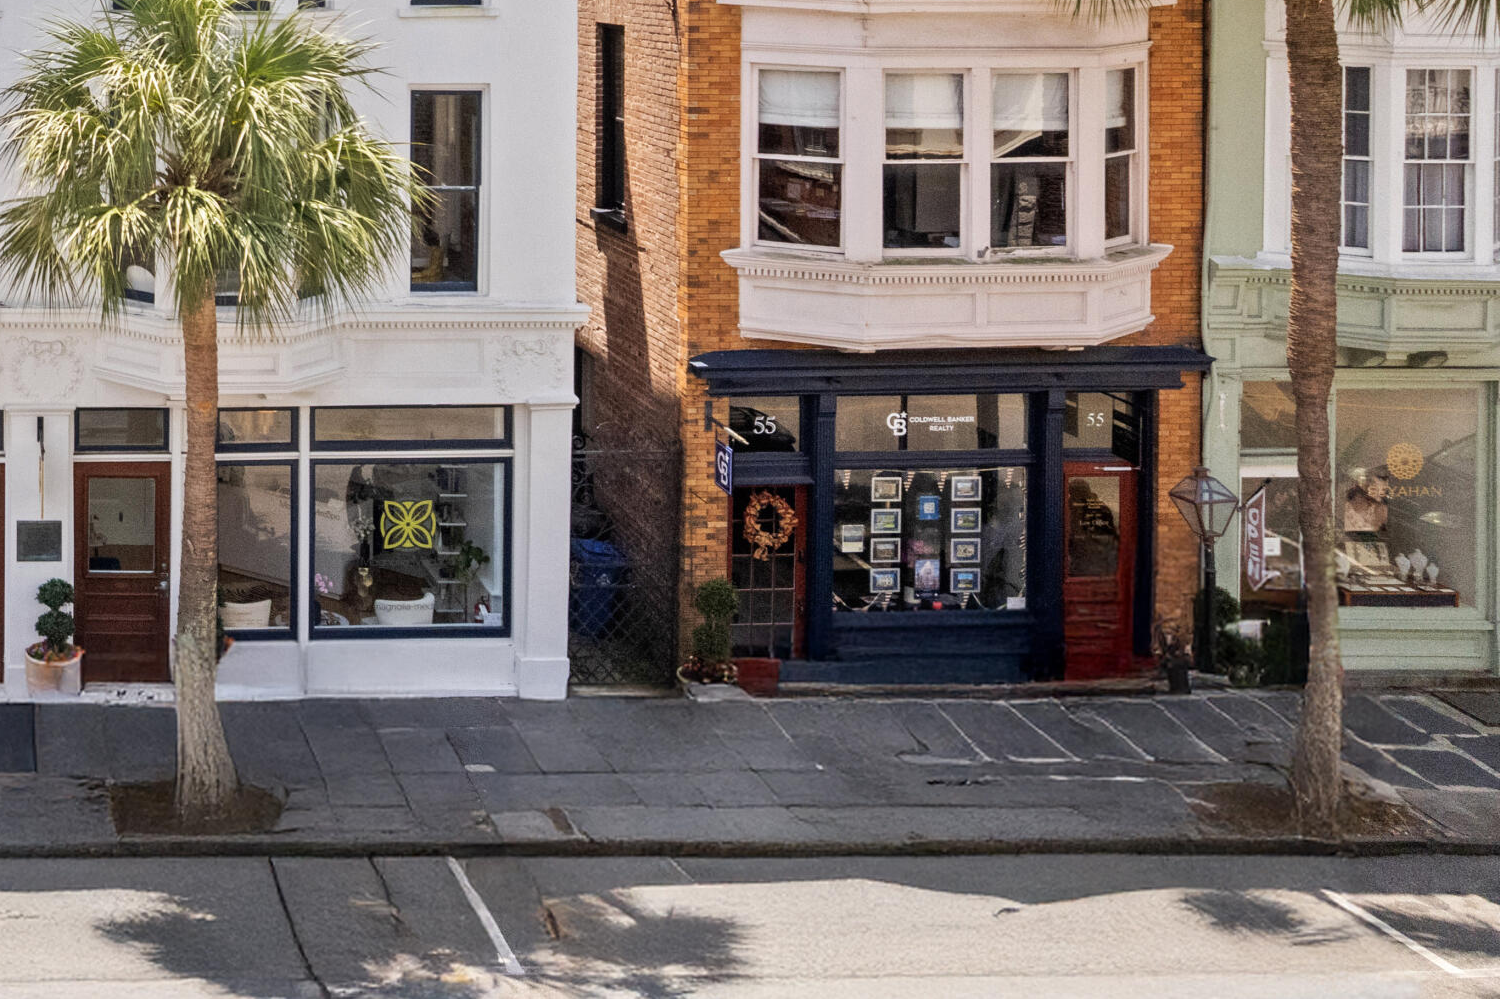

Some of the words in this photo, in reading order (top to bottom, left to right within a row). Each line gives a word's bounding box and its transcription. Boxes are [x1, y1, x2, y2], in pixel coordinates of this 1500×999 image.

[752, 415, 777, 435] 55
[1086, 412, 1105, 427] 55
[1247, 507, 1261, 581] OPEN
